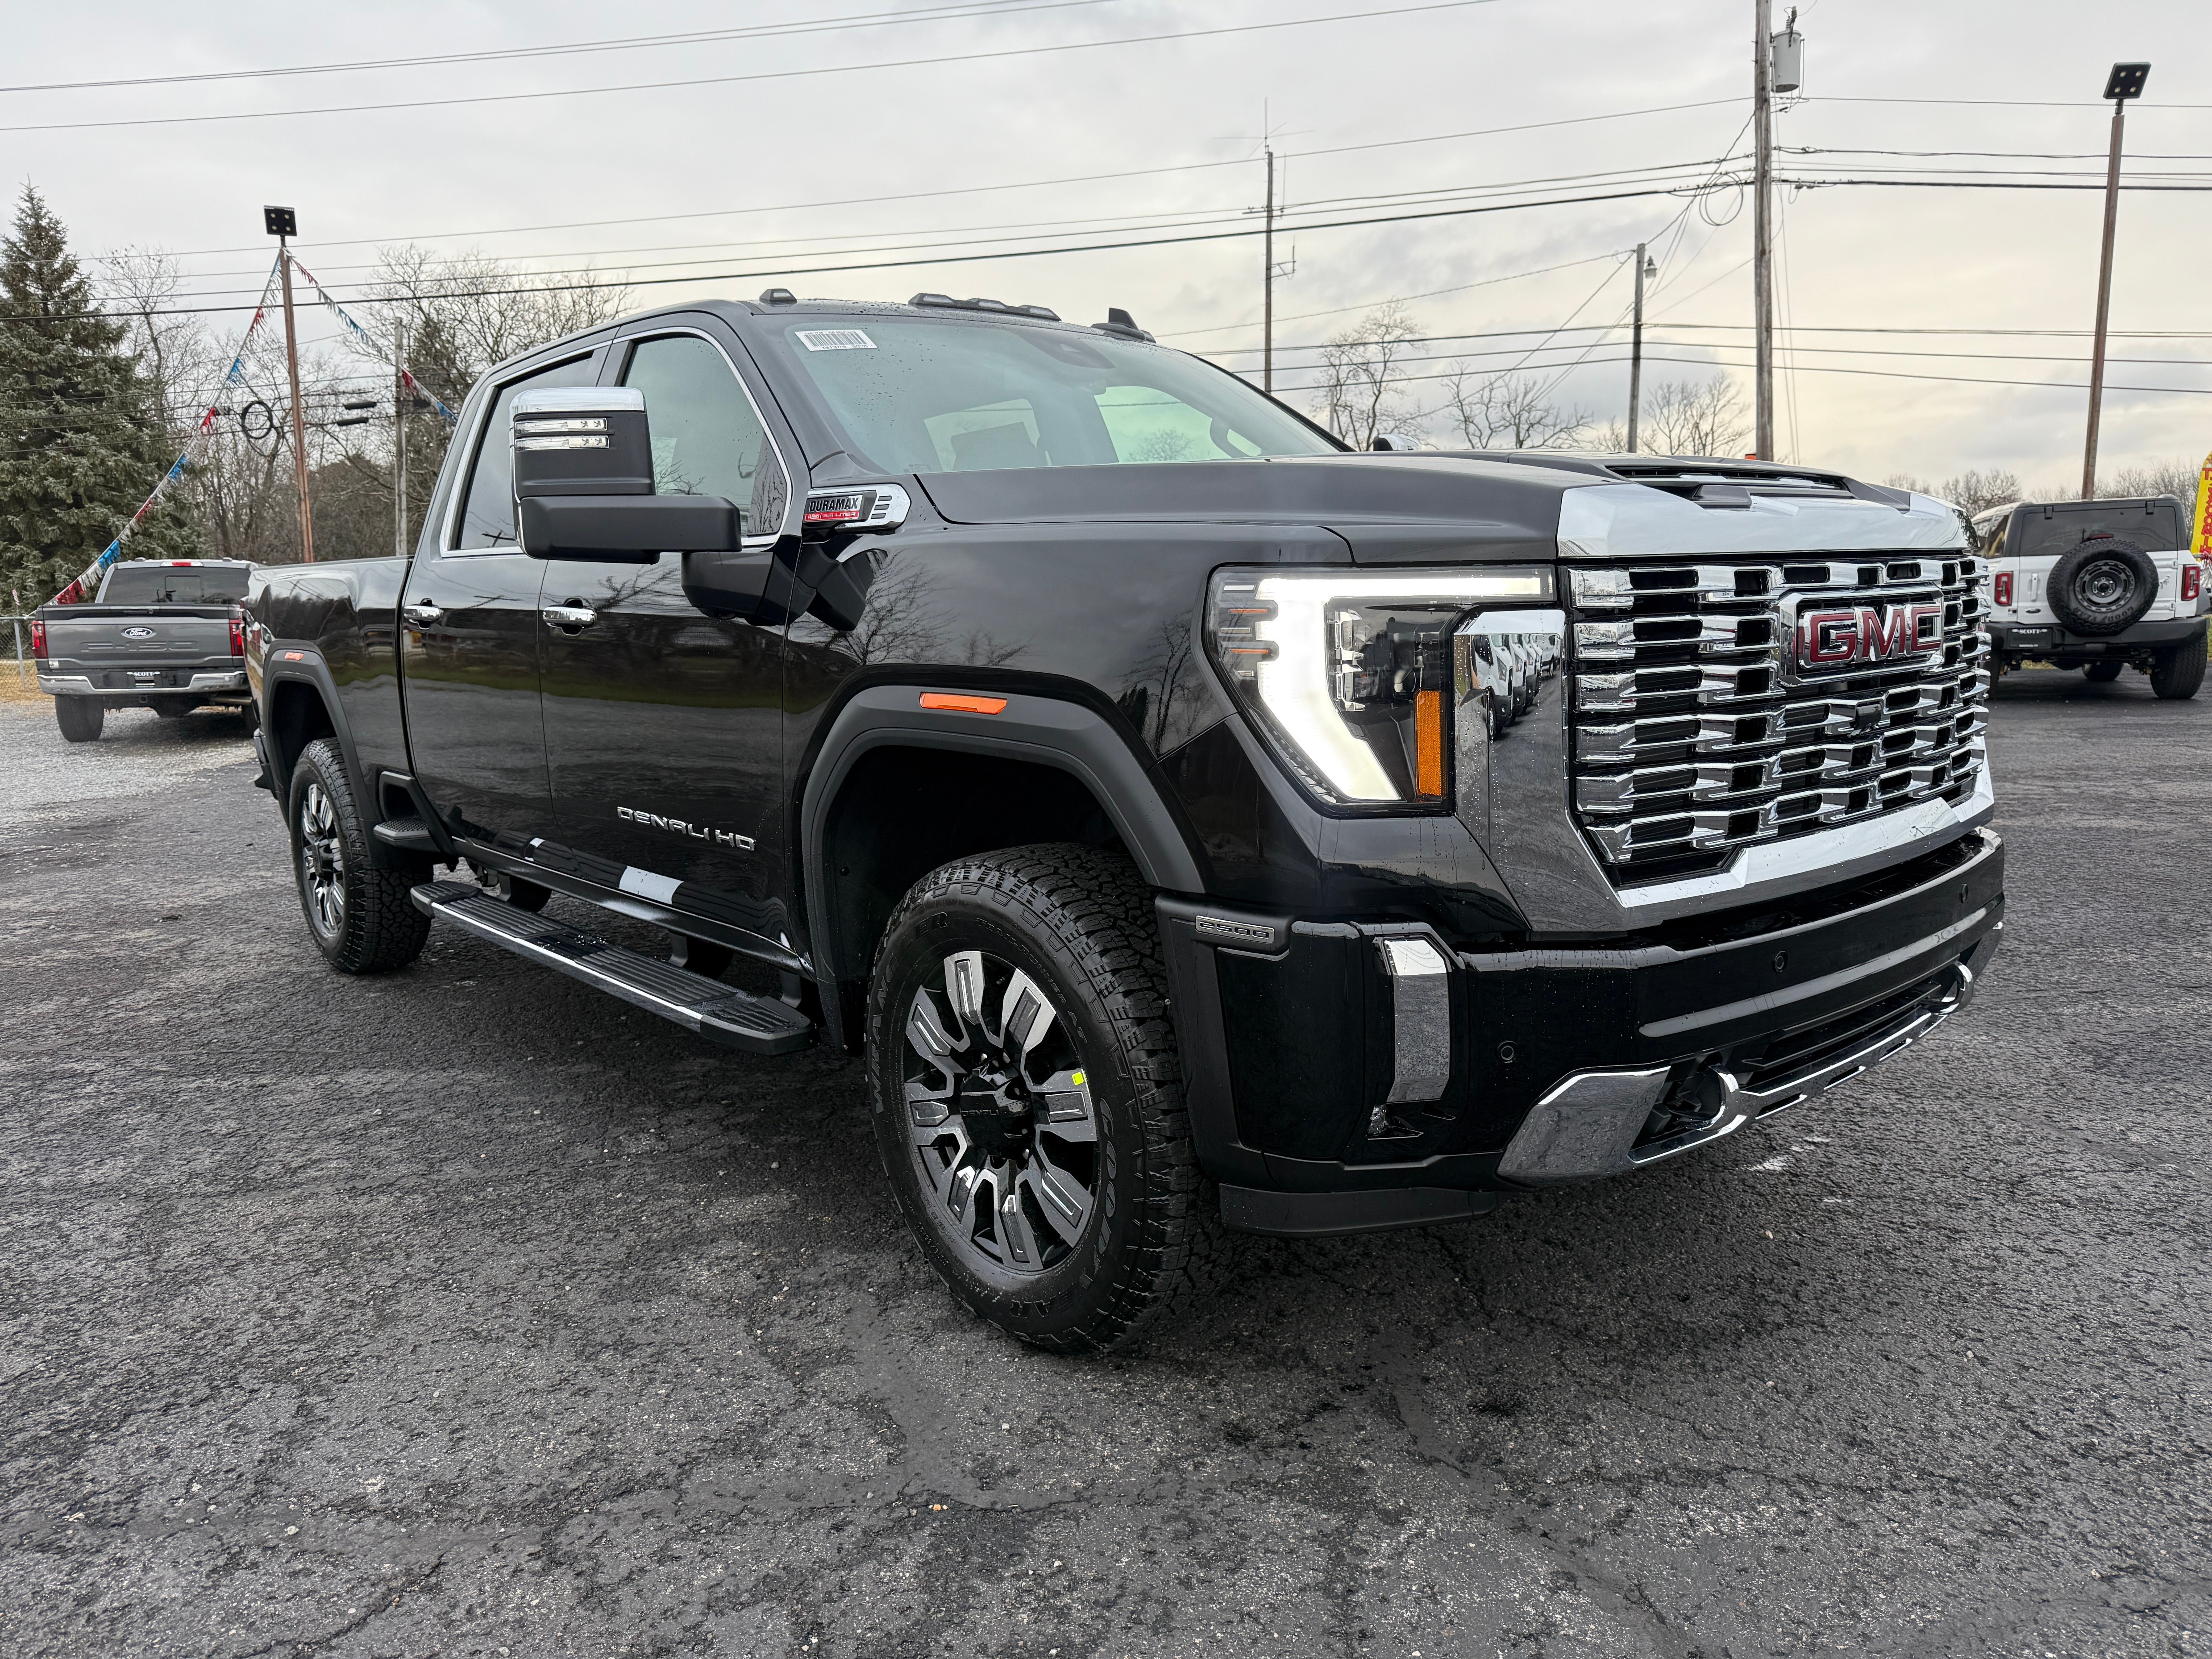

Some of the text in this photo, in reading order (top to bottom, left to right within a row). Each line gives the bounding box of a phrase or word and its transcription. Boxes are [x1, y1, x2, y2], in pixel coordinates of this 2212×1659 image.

[809, 497, 859, 512] DURAMAX
[1799, 603, 1941, 668] GMC
[617, 806, 756, 851] DENALI HD
[1199, 921, 1270, 939] 2500
